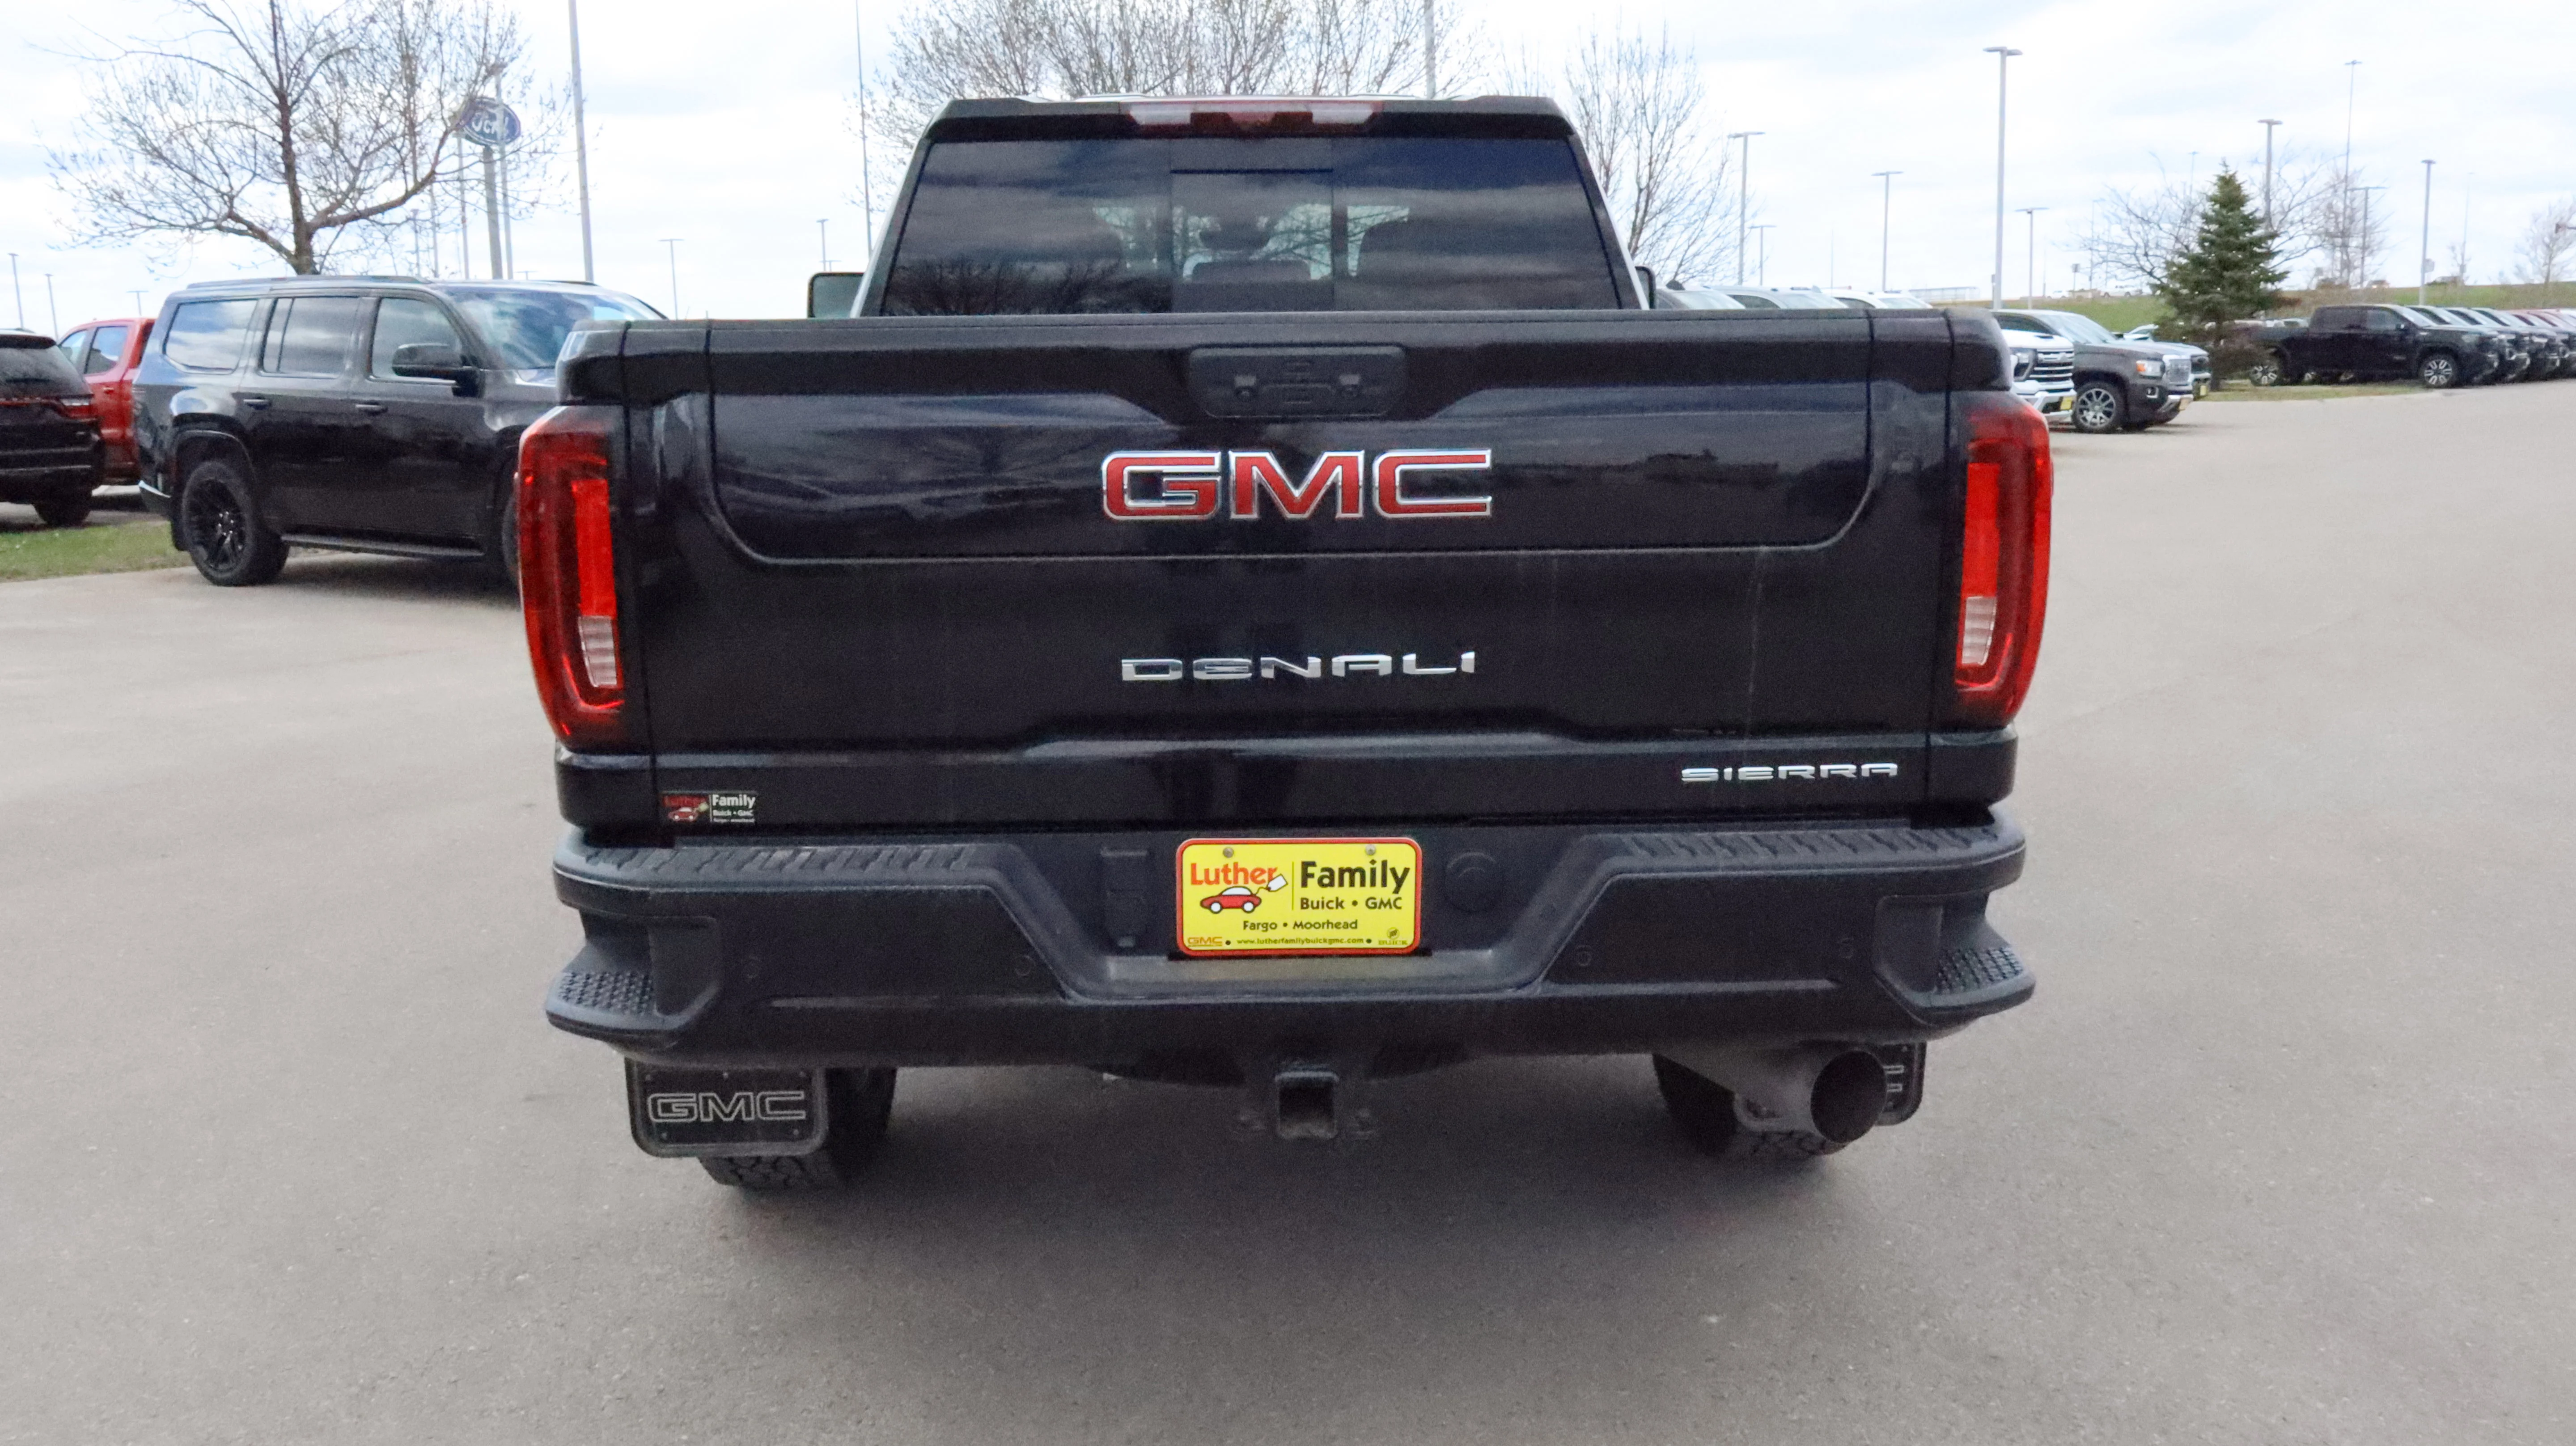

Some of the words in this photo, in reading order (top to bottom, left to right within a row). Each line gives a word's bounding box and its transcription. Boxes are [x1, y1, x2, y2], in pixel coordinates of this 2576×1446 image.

[1101, 449, 1492, 521] GMC
[1122, 651, 1475, 681] DENALI
[1681, 763, 1898, 782] SIERRA
[712, 794, 756, 809] Family
[1191, 863, 1277, 886] Luther
[1301, 859, 1410, 894] Family
[1301, 897, 1344, 910] Buick
[1365, 897, 1402, 910] GMC
[1243, 920, 1277, 931] Fargo
[1292, 920, 1358, 930] Moorhead
[648, 1091, 806, 1123] GMC
